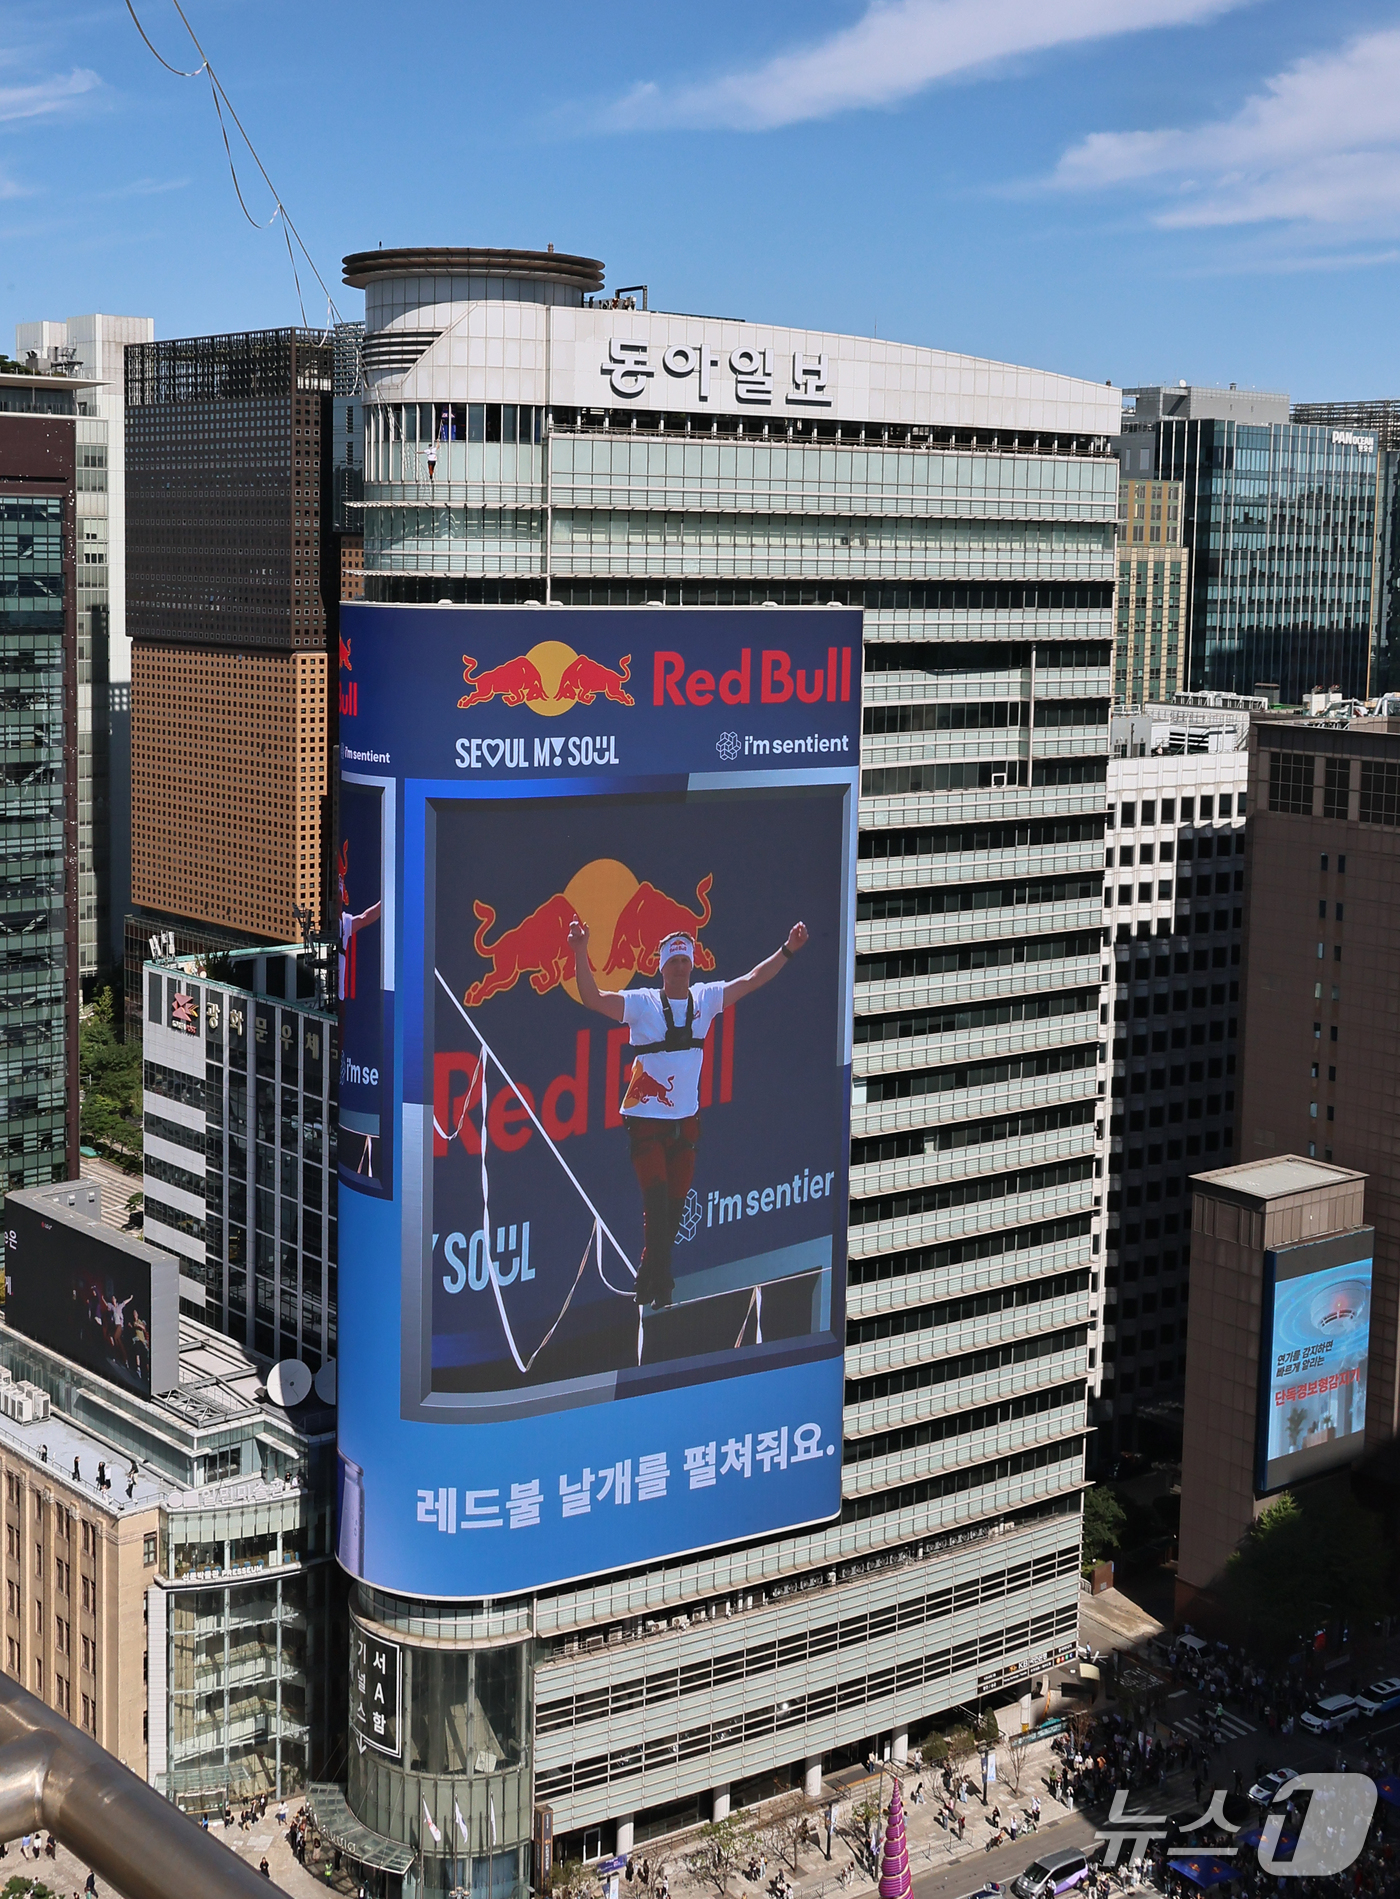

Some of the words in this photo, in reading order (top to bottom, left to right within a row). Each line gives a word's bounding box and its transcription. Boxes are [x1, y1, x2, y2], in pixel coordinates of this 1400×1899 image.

[600, 337, 834, 408] 동아일보
[1332, 431, 1353, 445] PAN
[1352, 435, 1374, 446] OCEAN
[652, 647, 751, 707] Red
[760, 646, 852, 704] Bull
[353, 749, 391, 764] sentient
[568, 735, 619, 767] SOUL
[743, 735, 770, 756] i'm
[772, 733, 849, 754] sentient
[346, 1057, 361, 1084] i'm
[706, 1190, 742, 1228] i'm
[1277, 1349, 1301, 1366] 연기를
[1302, 1339, 1334, 1359] 감지하면
[1276, 1363, 1300, 1378] 빠르게
[1301, 1356, 1325, 1372] 알리는
[1275, 1367, 1361, 1407] 단독경보형감지기
[416, 1477, 544, 1535] 레드불
[558, 1451, 672, 1519] 날개를
[683, 1422, 836, 1491] 펼쳐줘요.
[201, 1480, 285, 1507] 일민미술관
[221, 1564, 263, 1578] PRESSEUM
